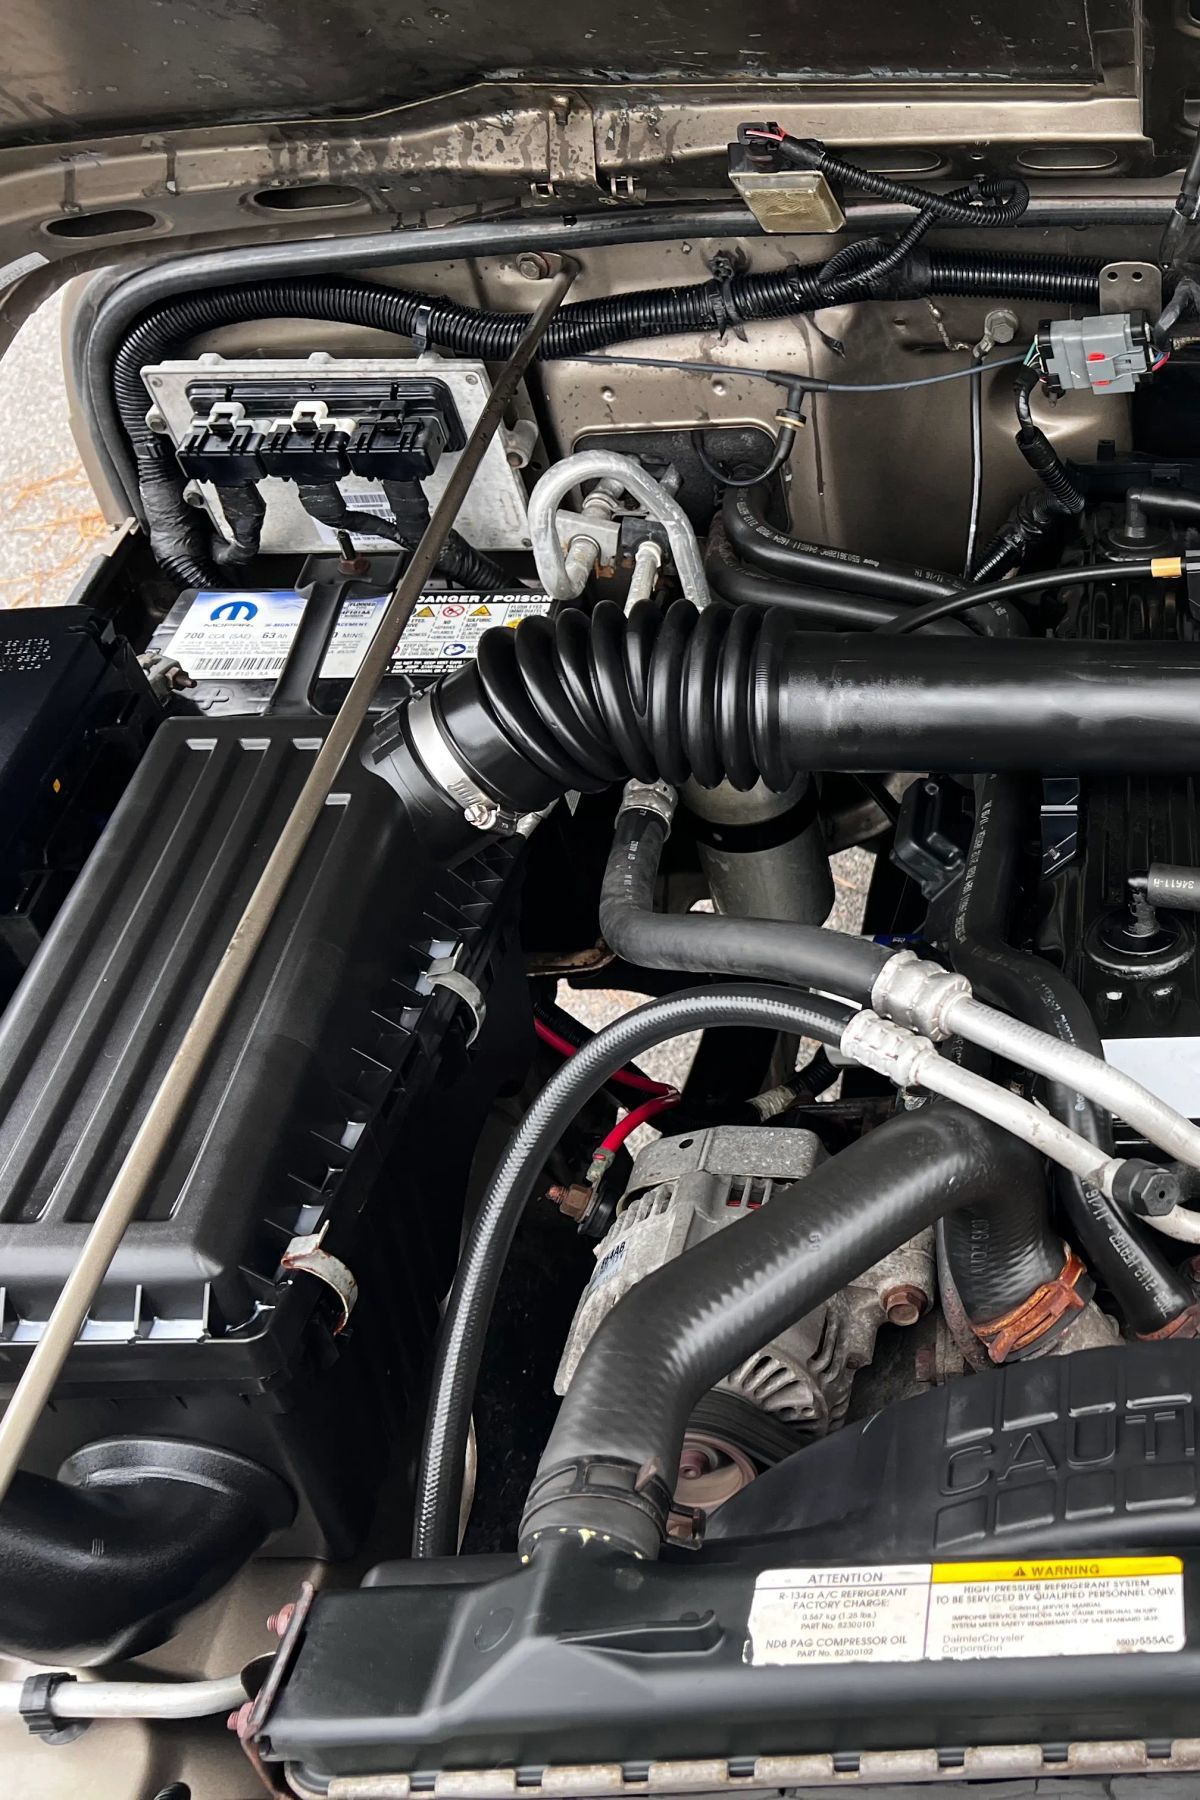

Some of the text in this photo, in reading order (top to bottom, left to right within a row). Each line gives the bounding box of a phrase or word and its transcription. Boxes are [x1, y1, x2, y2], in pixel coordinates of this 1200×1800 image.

[1031, 1564, 1100, 1577] WARNING
[808, 1572, 883, 1584] ATTENTION
[1044, 1581, 1110, 1591] REFRIGERANT
[1113, 1580, 1150, 1588] SYSTEM
[779, 1588, 908, 1600] R-134a A/C REFRIGERANT
[936, 1595, 949, 1605] TO
[952, 1595, 964, 1604] BE
[966, 1593, 1015, 1603] SERVICED
[1018, 1593, 1030, 1601] BY
[1033, 1590, 1085, 1601] QUALIFIED
[1088, 1588, 1145, 1598] PERSONNEL
[793, 1599, 889, 1609] FACTORY CHARGE:
[766, 1635, 908, 1649] ND8 PAG COMPRESSOR OIL
[943, 1633, 1025, 1645] DaimlerChrysler
[942, 1645, 1003, 1654] Corporation
